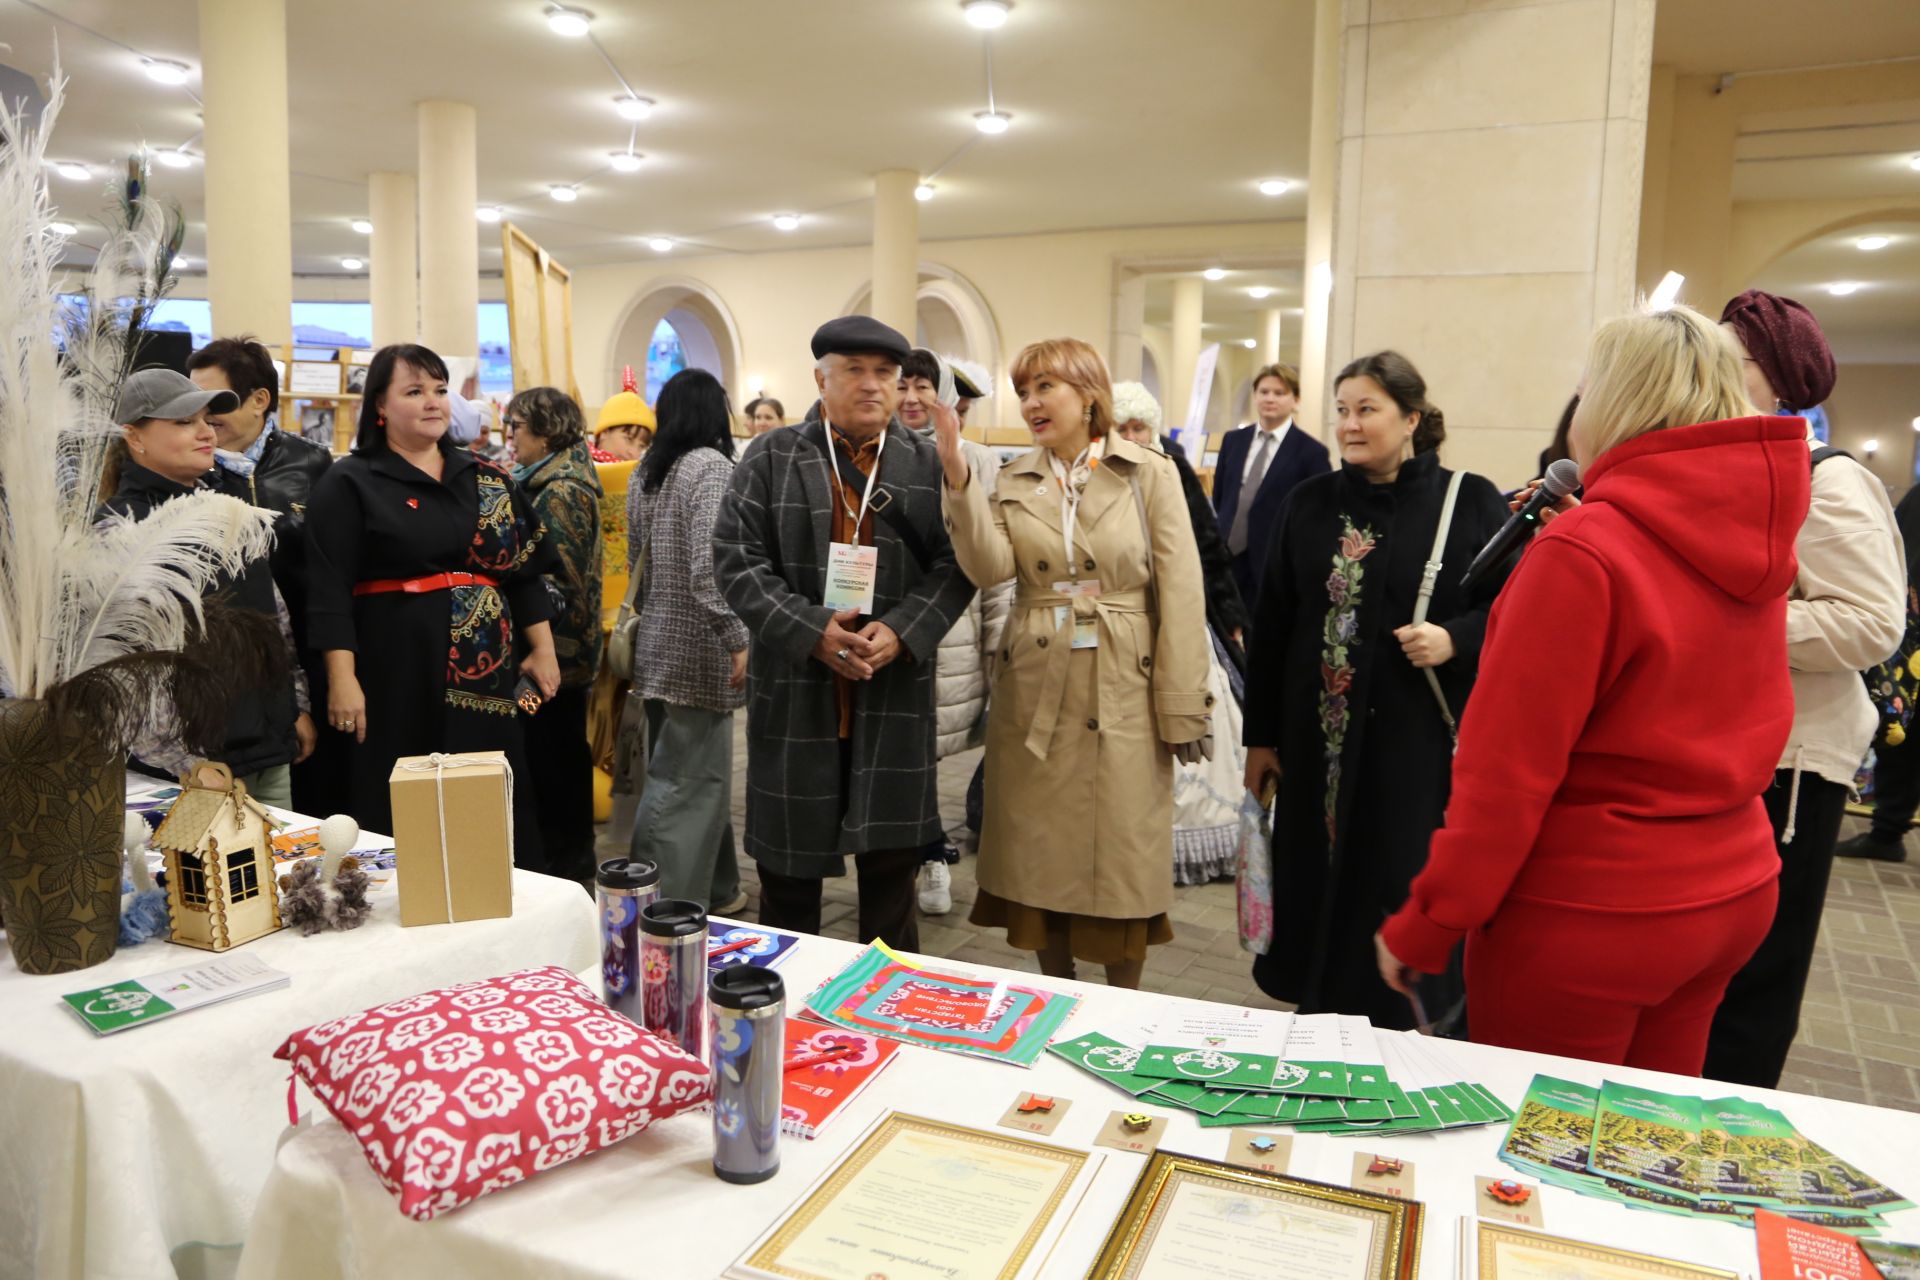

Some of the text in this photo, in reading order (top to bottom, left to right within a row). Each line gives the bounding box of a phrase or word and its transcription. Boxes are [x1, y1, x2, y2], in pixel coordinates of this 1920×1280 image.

[914, 1007, 966, 1019] Татарстан
[1786, 1233, 1847, 1254] родном
[1787, 1241, 1860, 1265] отдыхай
